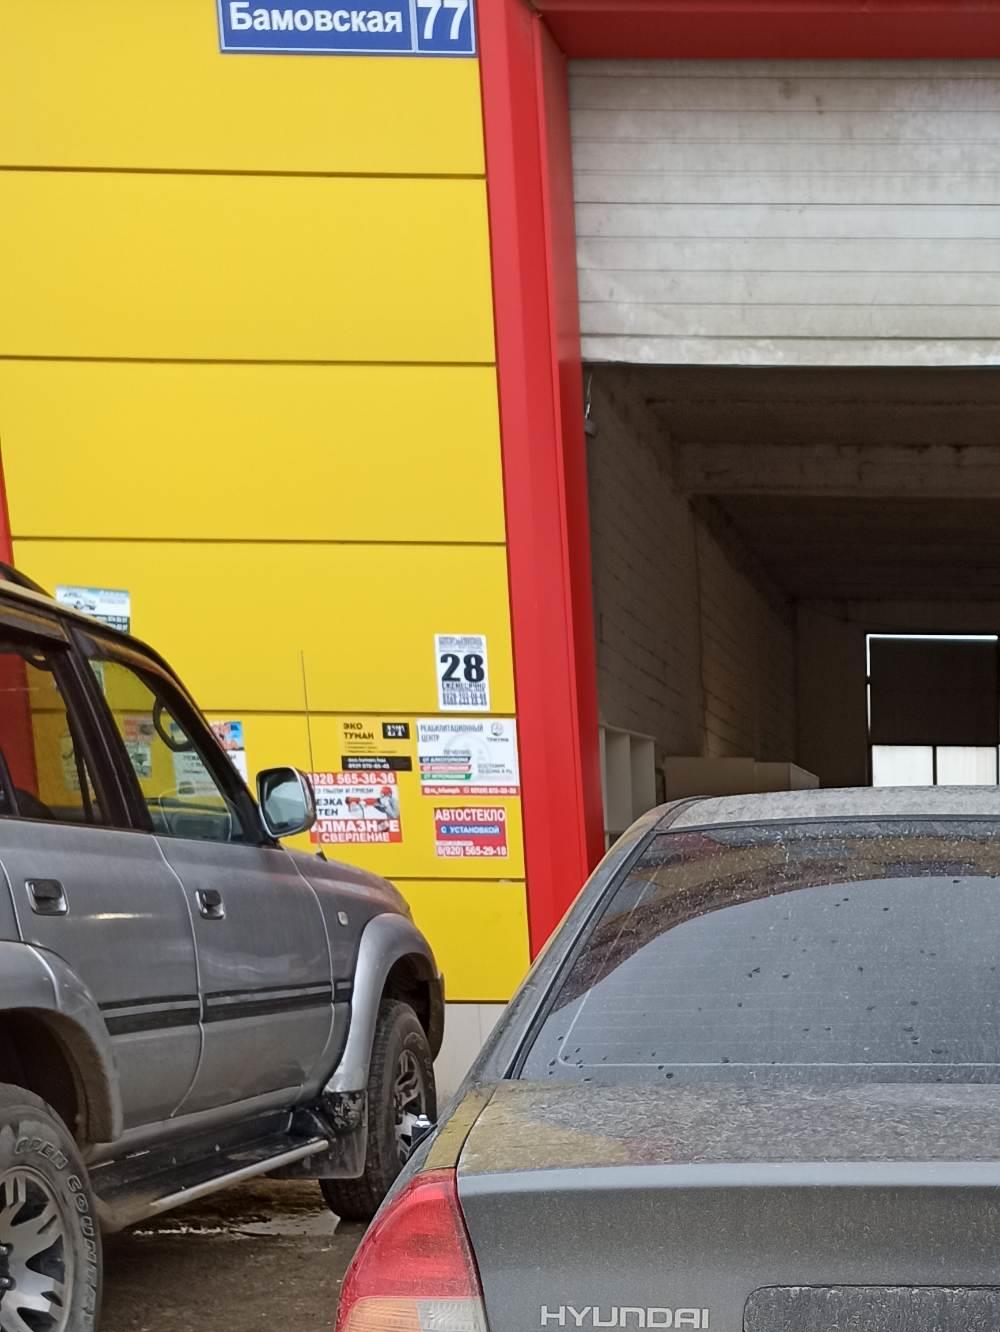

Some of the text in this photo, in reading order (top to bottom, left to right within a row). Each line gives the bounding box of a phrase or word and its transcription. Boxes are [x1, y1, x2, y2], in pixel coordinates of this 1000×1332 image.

[229, 0, 468, 39] Бамовская 77
[440, 653, 485, 682] 28
[343, 722, 363, 730] ЭКО
[435, 809, 505, 822] АВТОСТЕКЛО
[450, 825, 499, 834] УСТАНОВКОЙ
[322, 833, 390, 843] СВЕРЛЕНИЕ
[540, 1304, 710, 1329] HYUNDAI
